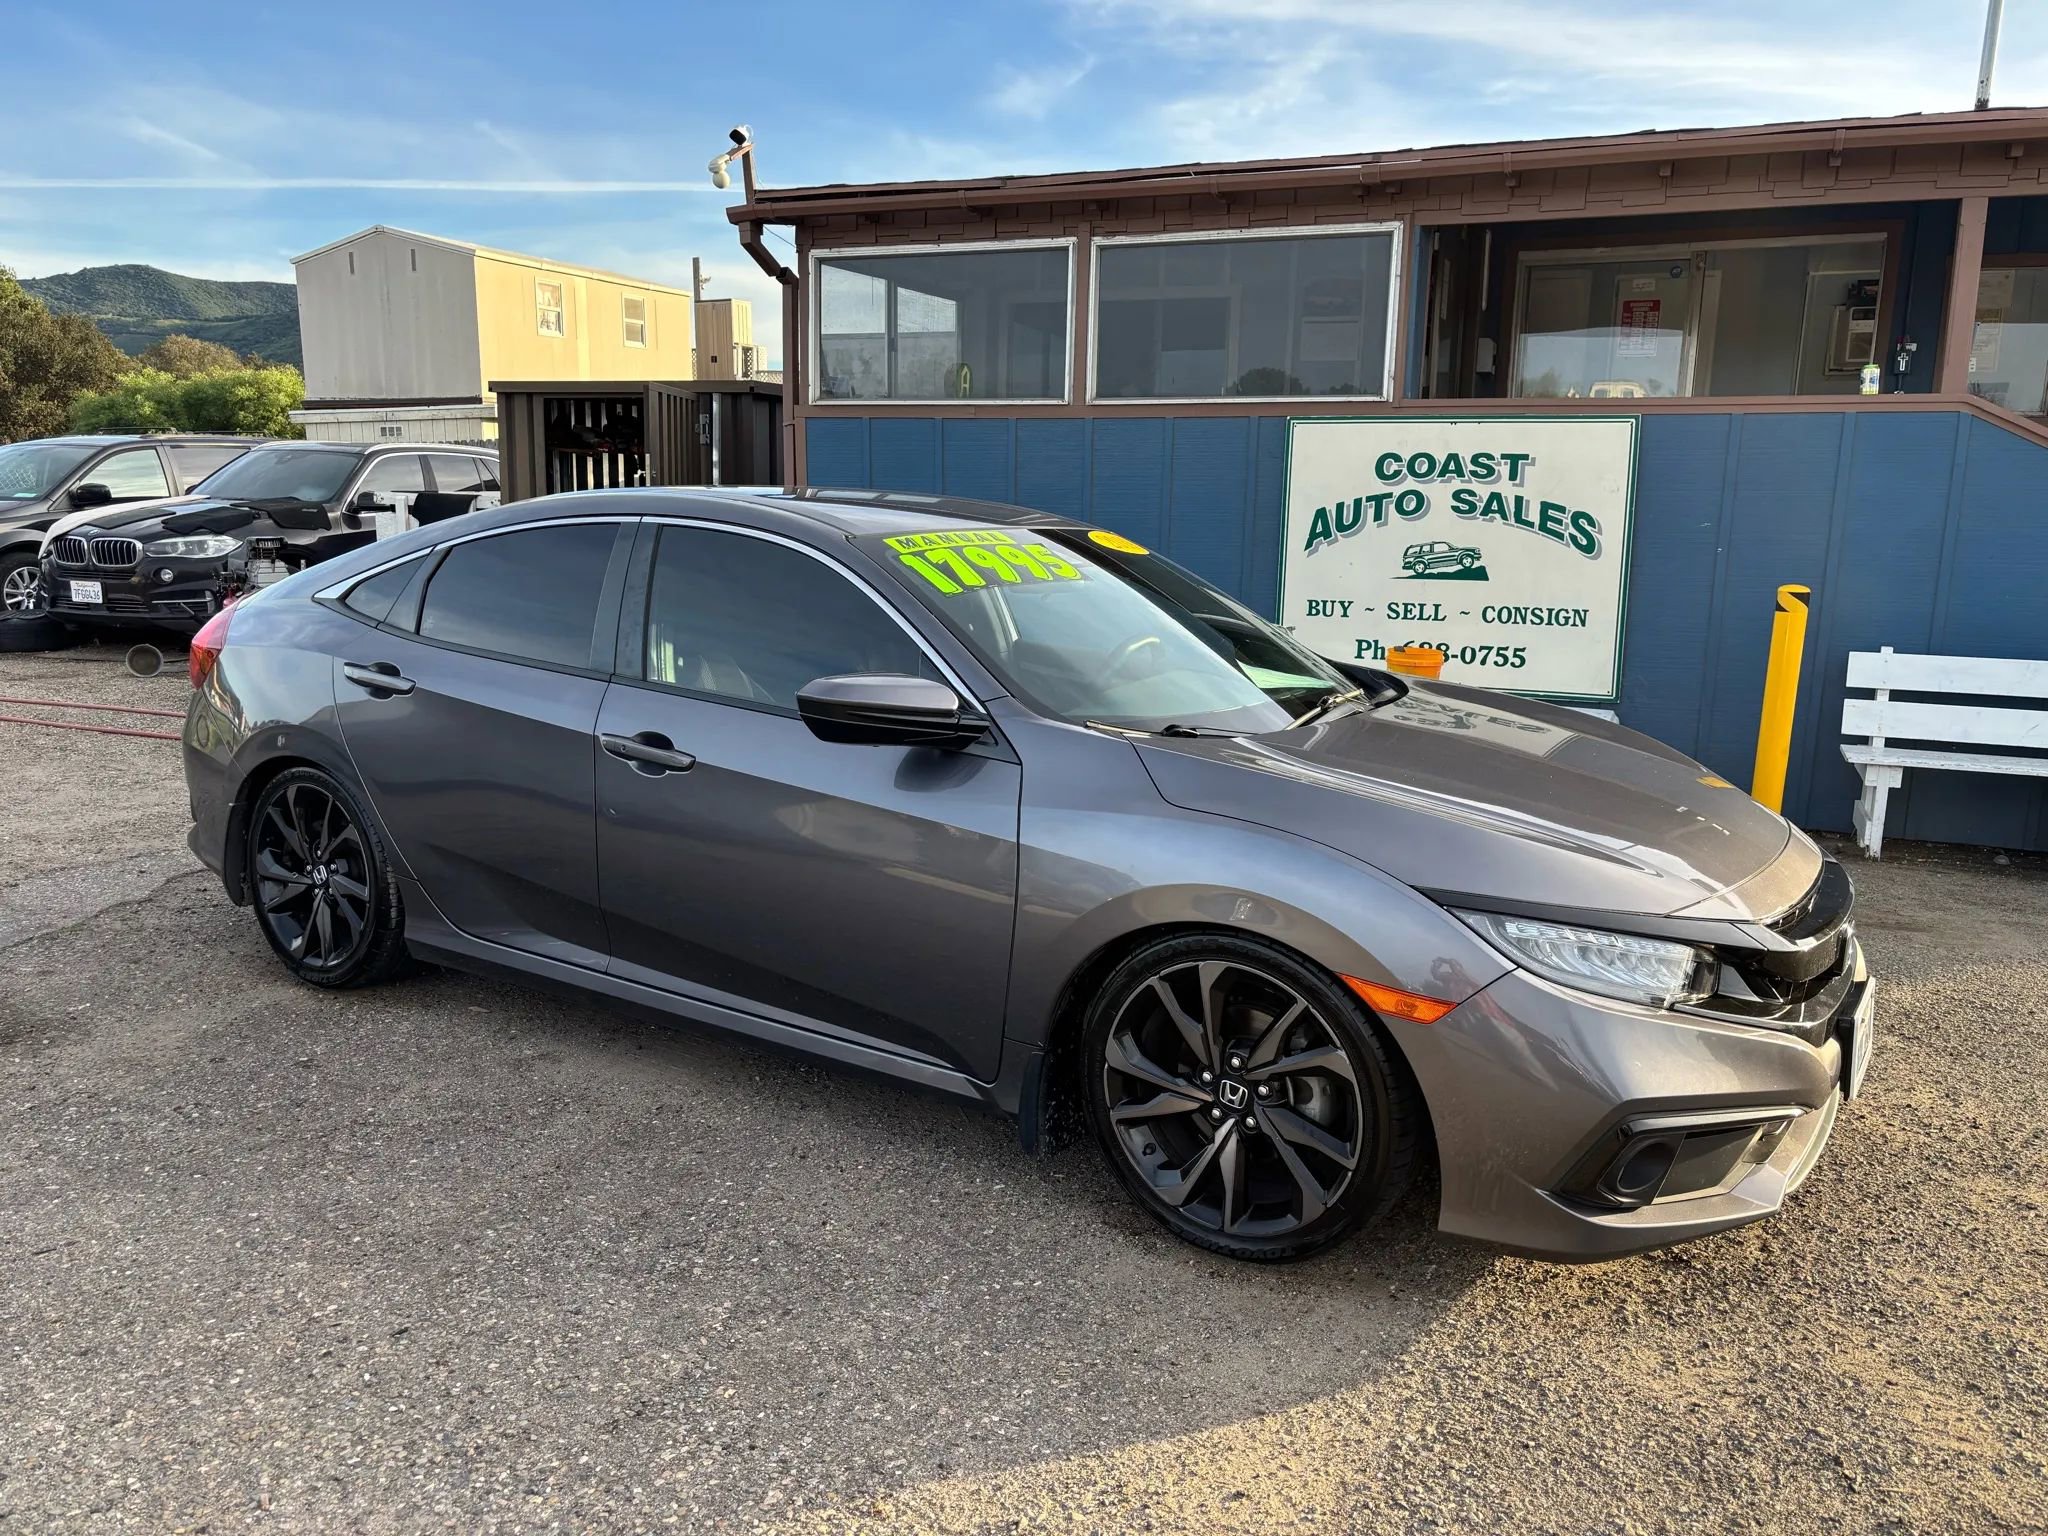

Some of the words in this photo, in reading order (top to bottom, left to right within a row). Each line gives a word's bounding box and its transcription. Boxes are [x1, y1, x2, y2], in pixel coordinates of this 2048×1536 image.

[1375, 453, 1532, 484] COAST
[1304, 489, 1427, 552] AUTO
[1449, 489, 1599, 557] SALES
[895, 532, 1006, 549] MANUAL
[899, 543, 1083, 594] 17995
[1306, 600, 1353, 617] BUY
[1387, 602, 1447, 621] SELL
[1482, 605, 1589, 627] CONSIGN
[1402, 641, 1527, 668] 8-0755
